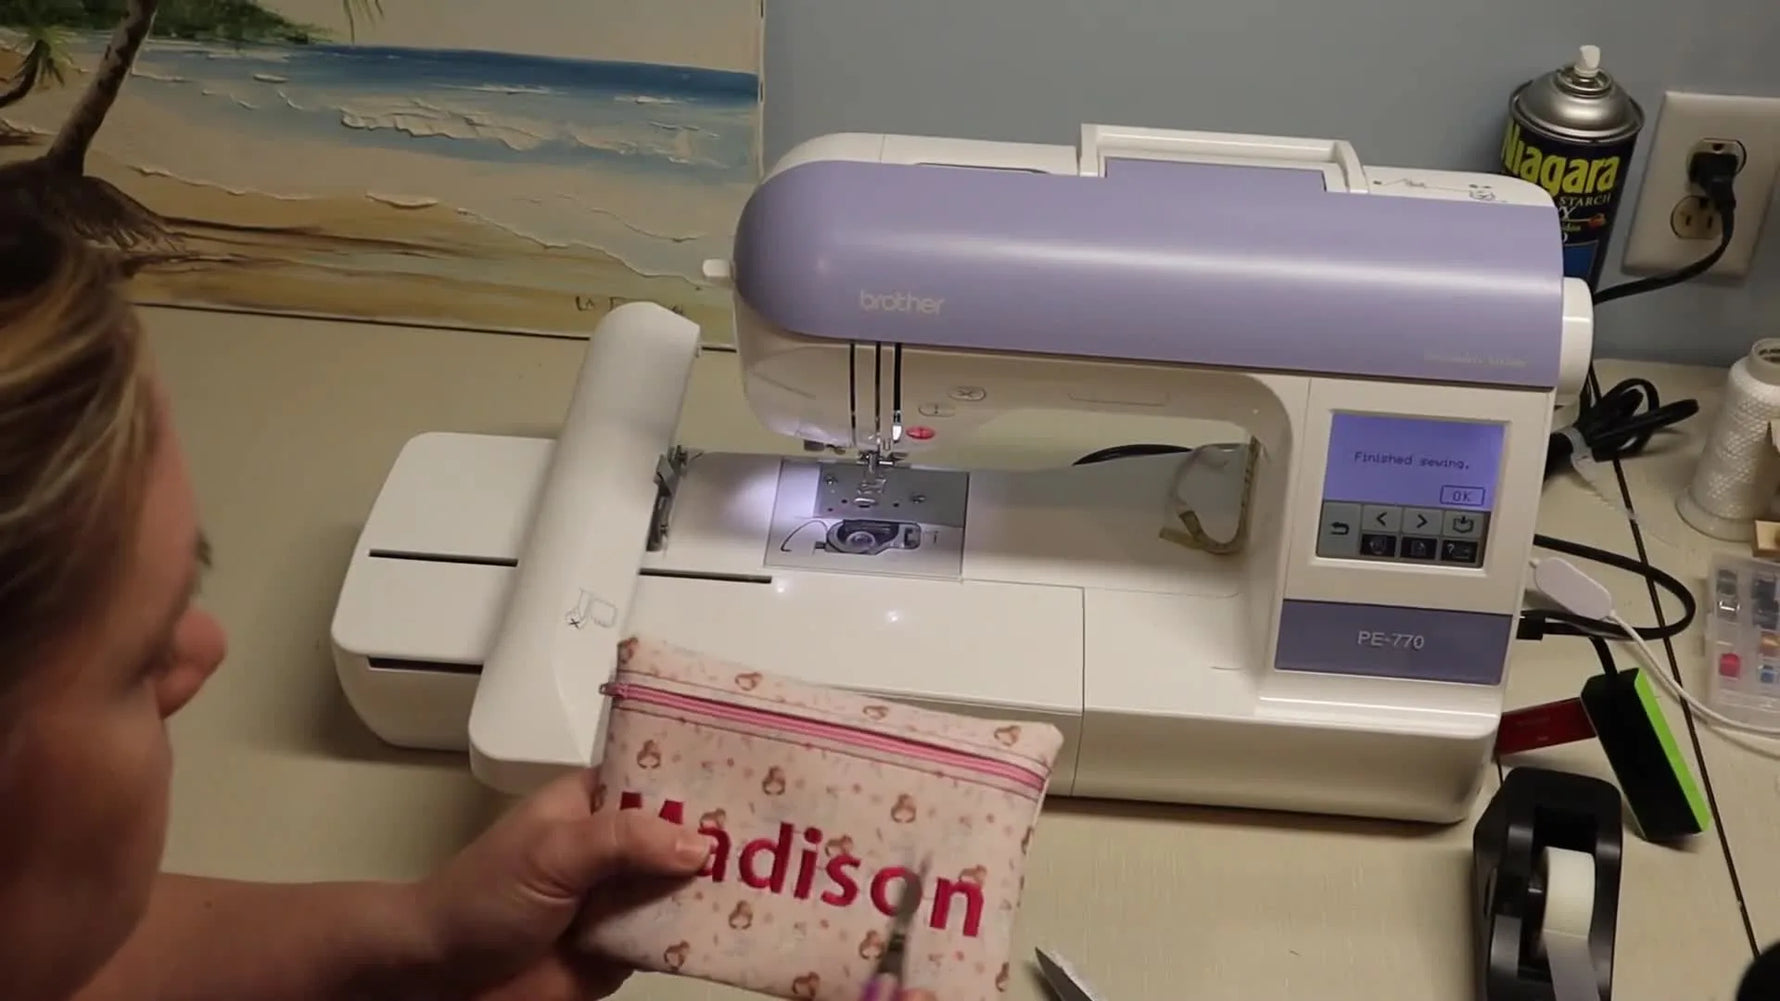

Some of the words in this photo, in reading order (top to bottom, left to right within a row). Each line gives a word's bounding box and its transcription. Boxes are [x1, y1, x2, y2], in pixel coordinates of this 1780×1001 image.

[1501, 118, 1620, 197] Niagara
[860, 288, 945, 315] brother
[1354, 451, 1413, 465] Finished
[1452, 490, 1471, 502] OK
[1357, 630, 1425, 650] PE-770
